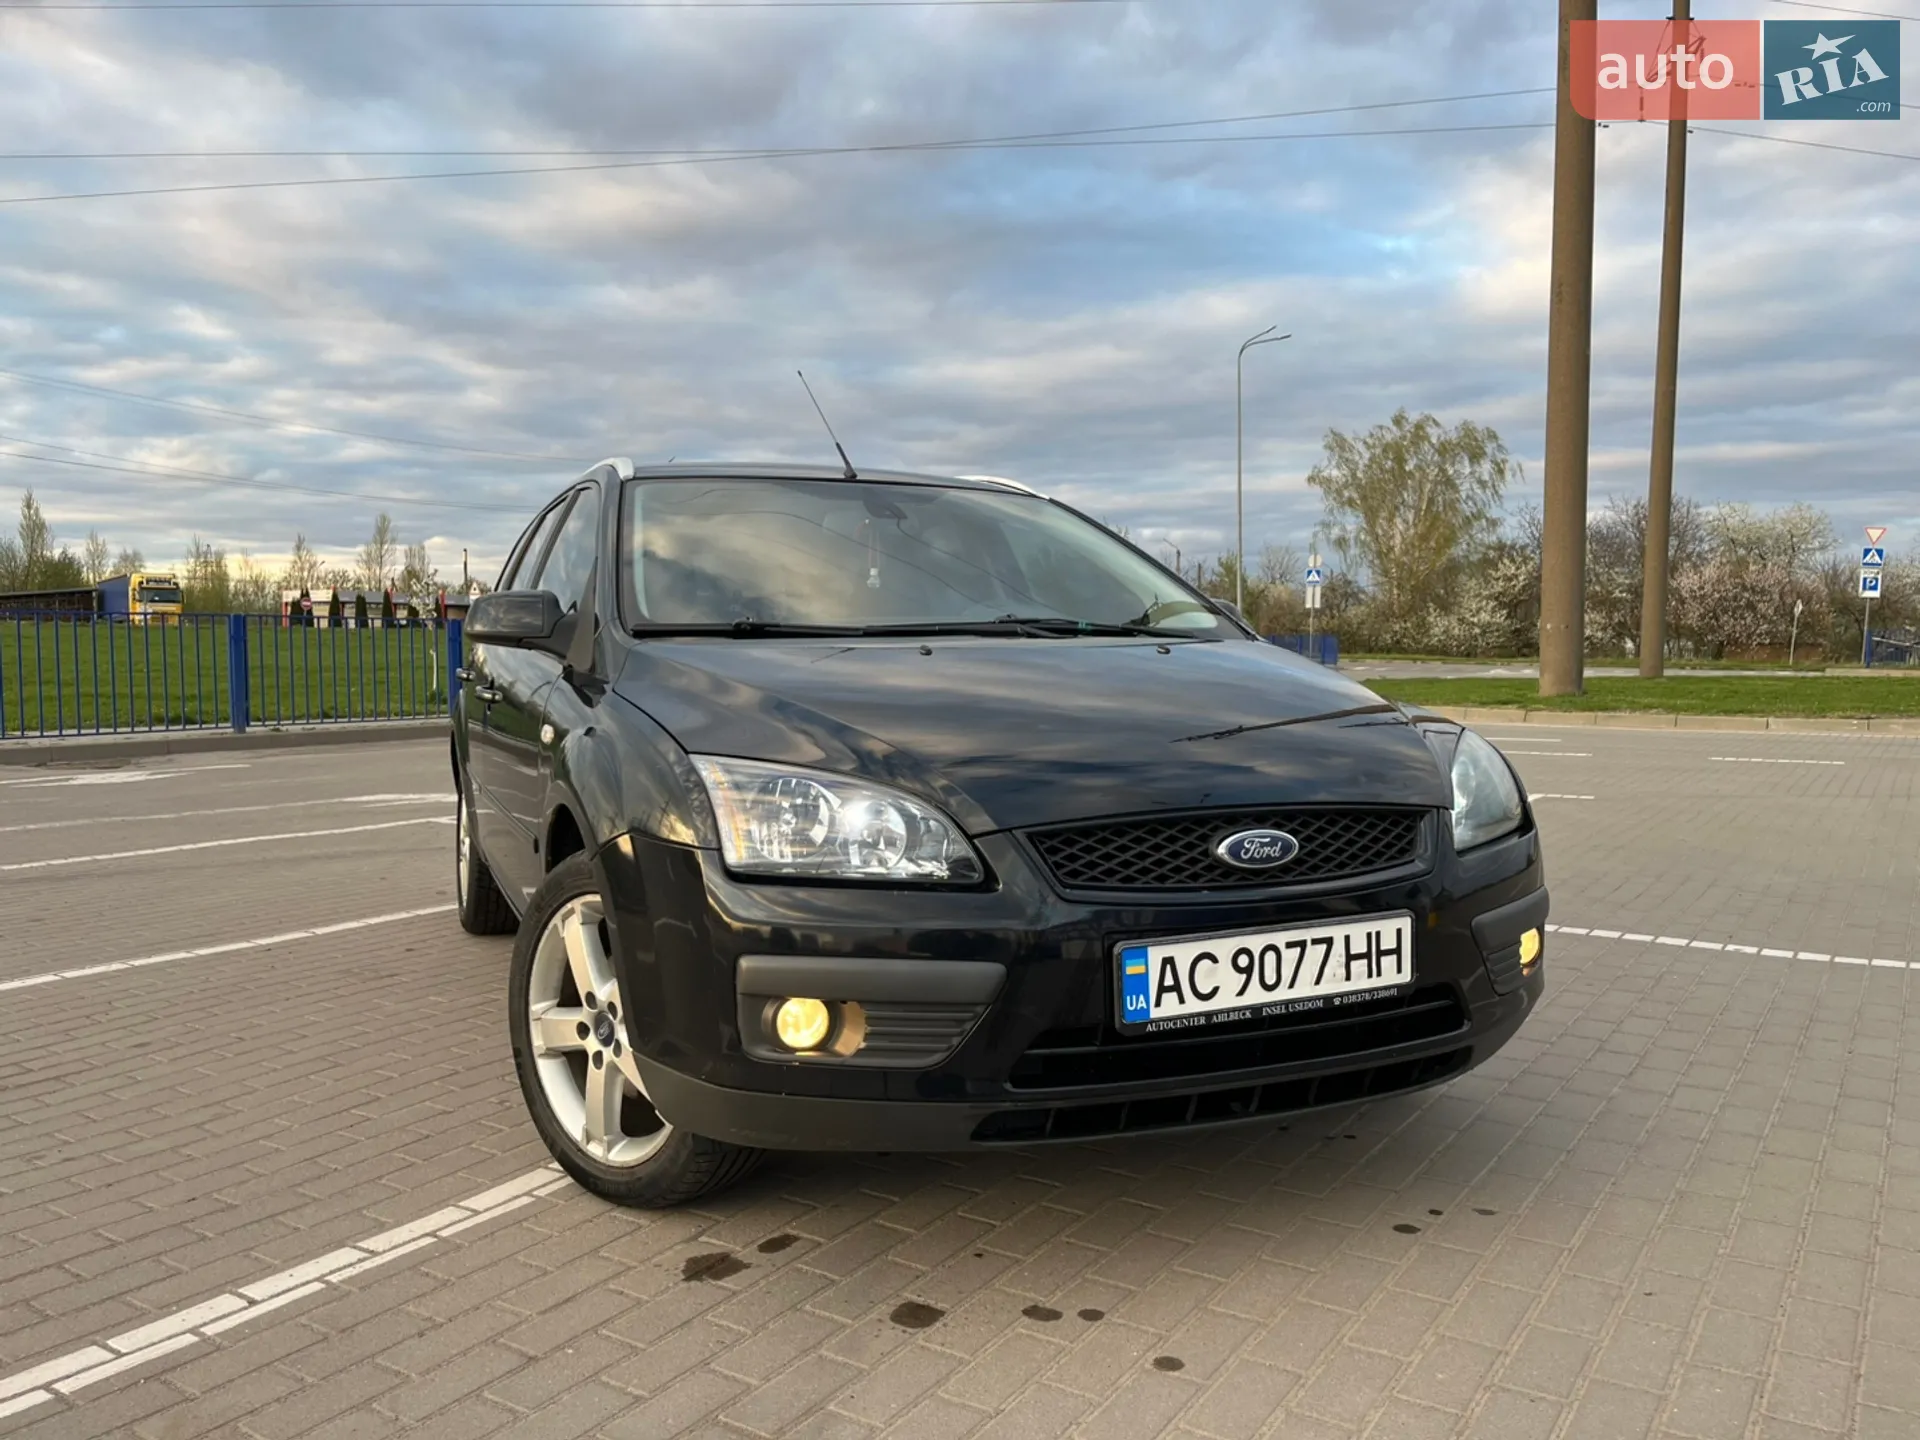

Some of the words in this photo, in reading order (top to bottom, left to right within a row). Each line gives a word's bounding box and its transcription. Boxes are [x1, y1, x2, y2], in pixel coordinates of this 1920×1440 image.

[1240, 837, 1282, 859] Ford
[1153, 951, 1220, 1008] AC
[1230, 936, 1334, 997] 9077
[1343, 927, 1403, 982] HH
[1126, 994, 1148, 1011] UA
[1146, 1016, 1206, 1032] AUTOCENTER
[1211, 1009, 1252, 1023] AHLBECK
[1262, 1004, 1287, 1016] INSEL
[1288, 999, 1324, 1012] USEDOM
